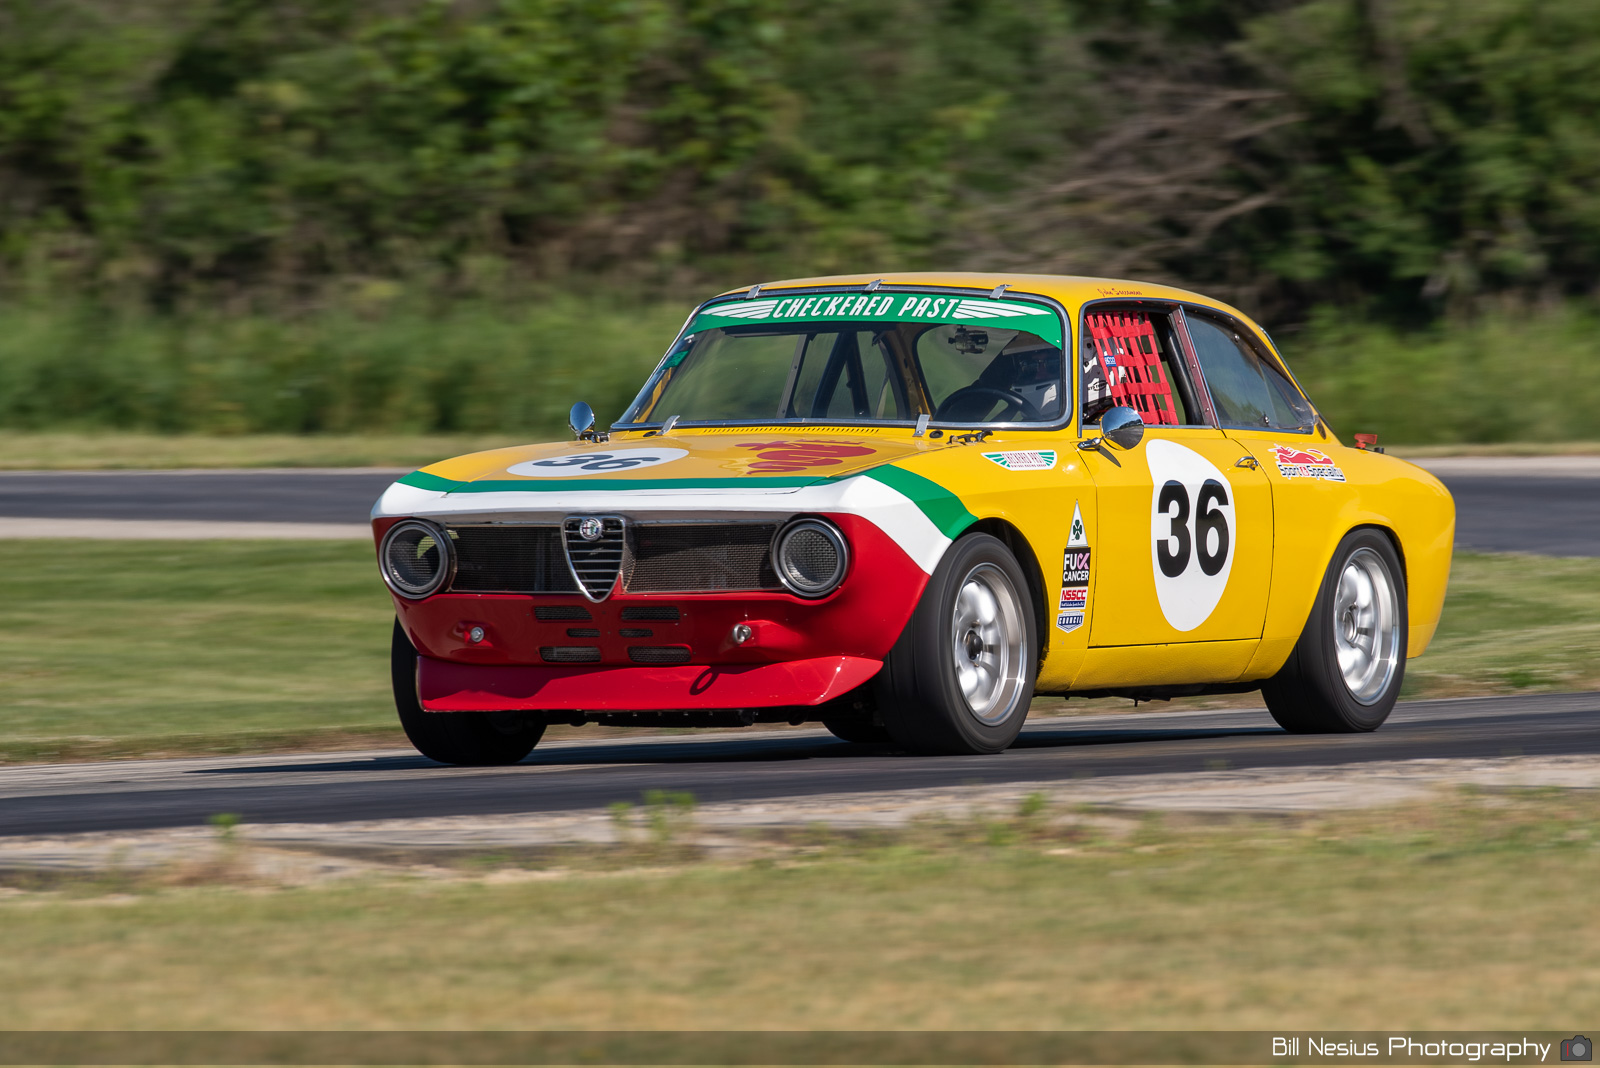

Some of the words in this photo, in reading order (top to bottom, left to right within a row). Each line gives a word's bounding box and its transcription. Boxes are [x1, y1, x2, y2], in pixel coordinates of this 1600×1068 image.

[772, 296, 894, 318] CHECKERED
[897, 296, 960, 319] PAST
[532, 454, 661, 470] 36
[1156, 478, 1230, 578] 36
[1063, 570, 1089, 582] CANCER
[1061, 589, 1087, 600] NSSCC
